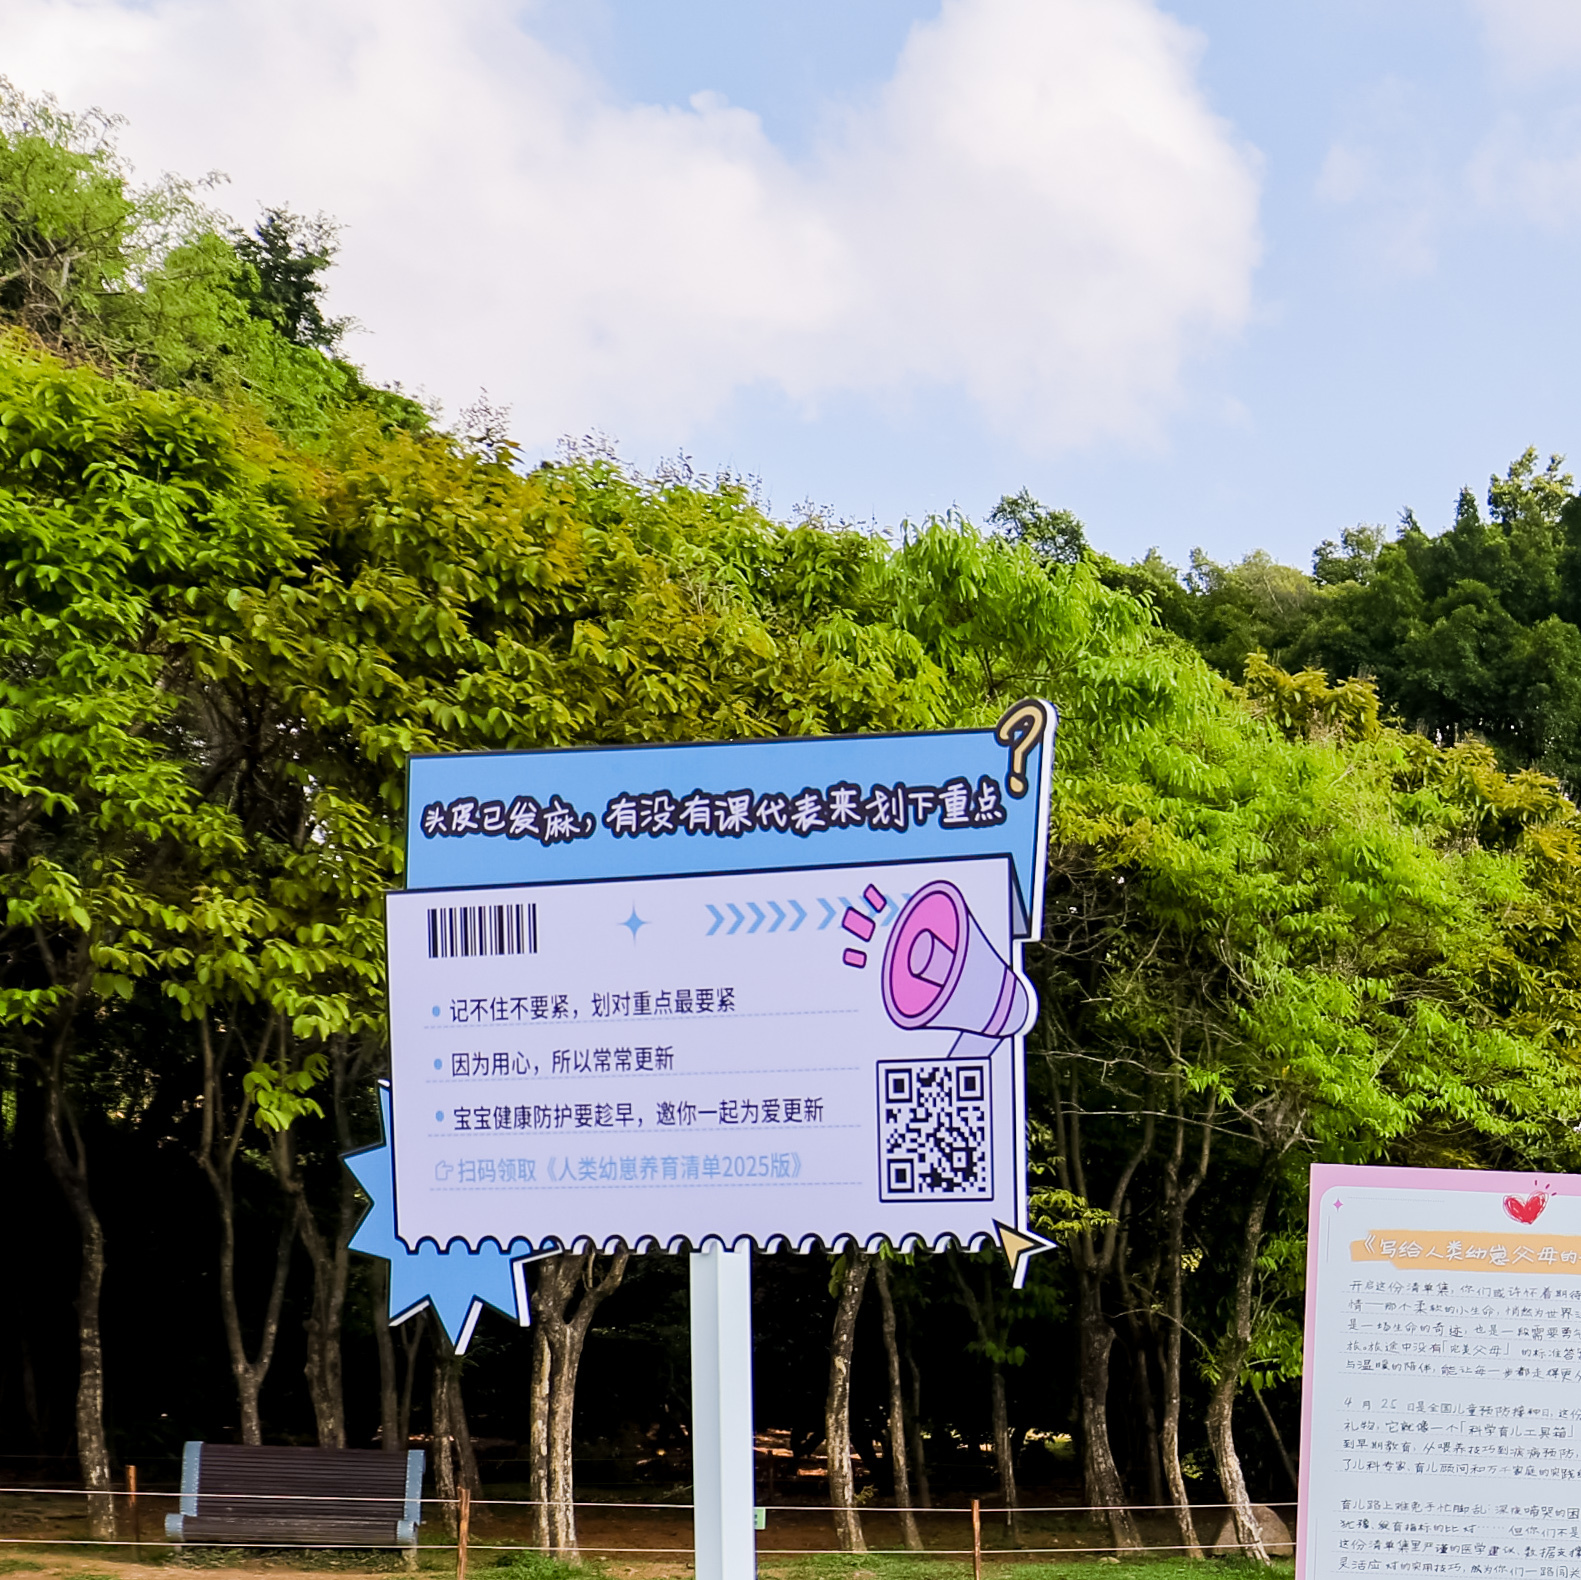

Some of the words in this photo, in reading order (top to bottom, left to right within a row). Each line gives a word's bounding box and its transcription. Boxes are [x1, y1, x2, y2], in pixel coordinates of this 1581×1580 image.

[450, 986, 736, 1024] 记不住不要紧，划对重点最要紧
[451, 1045, 675, 1077] 因为用心，所以常常更新
[453, 1096, 824, 1131] 宝宝健康防护要趁早，邀你一起为爱更新
[457, 1153, 807, 1183] 扫码领取《人类幼崽养育清单2025版》
